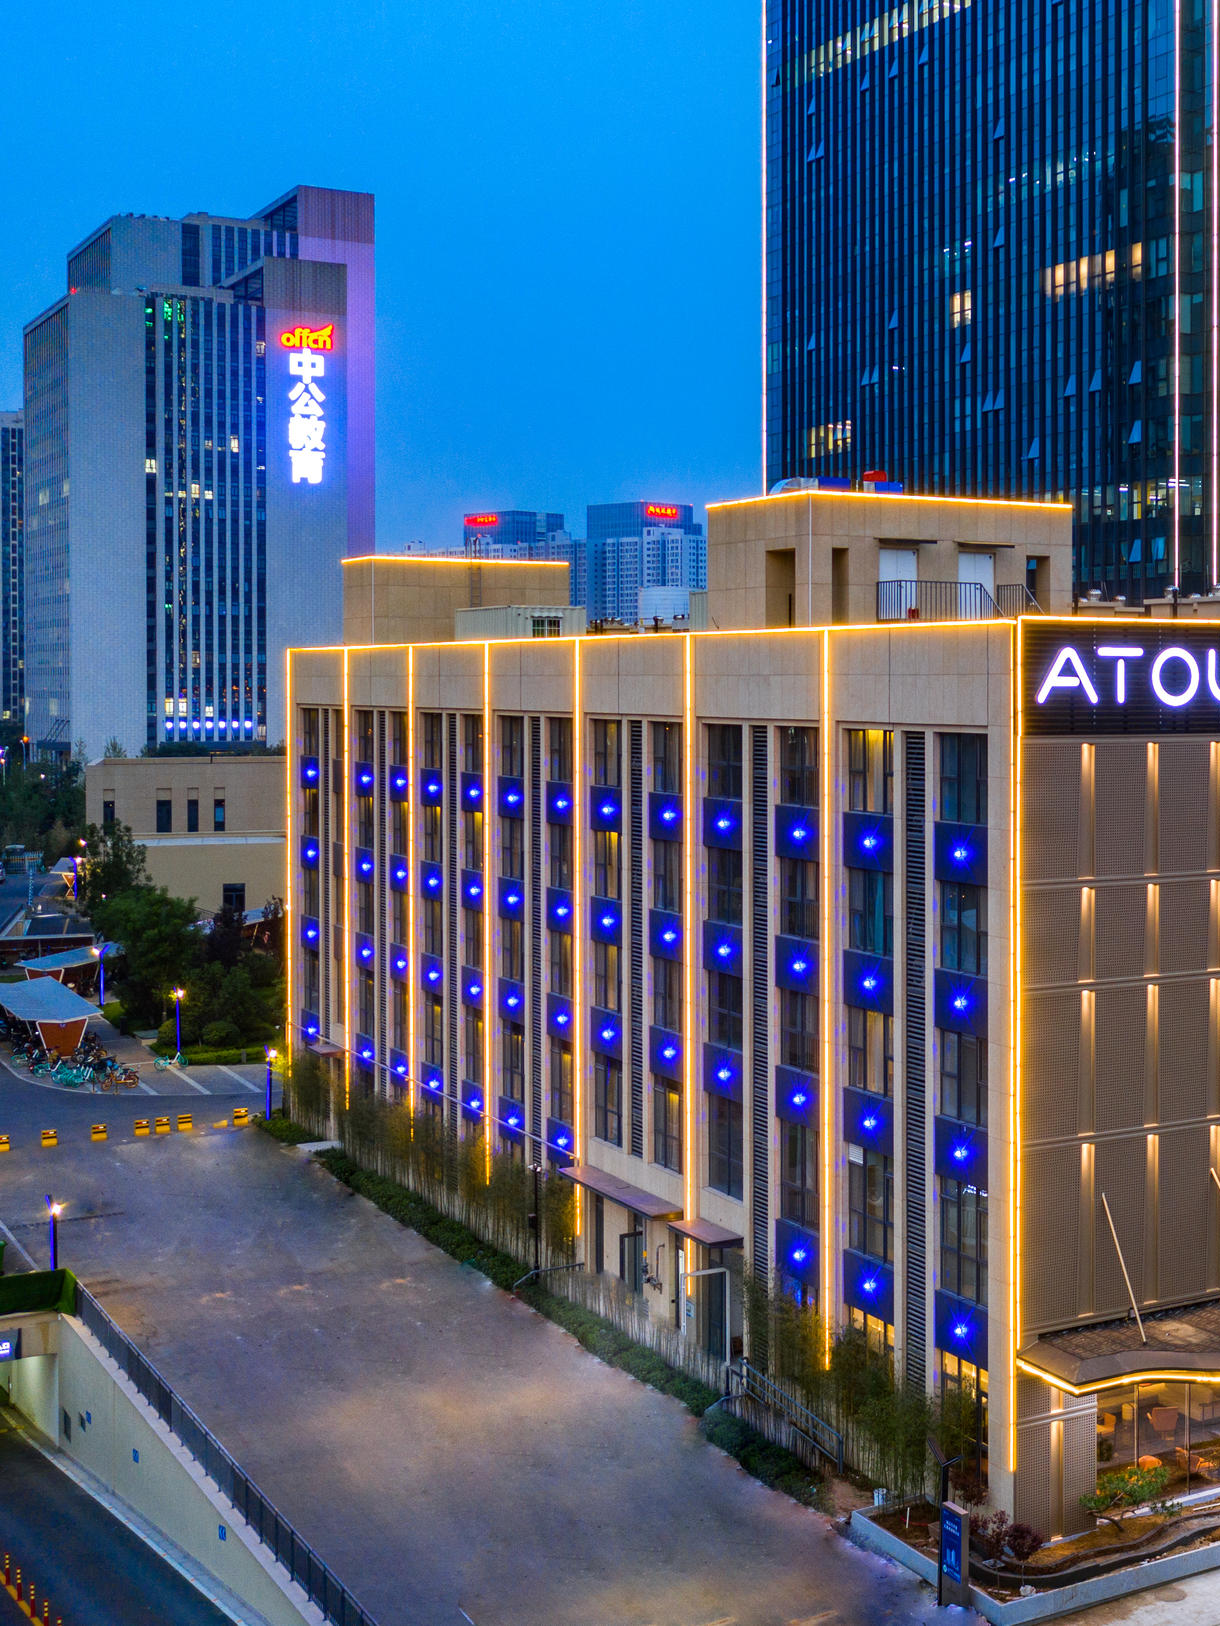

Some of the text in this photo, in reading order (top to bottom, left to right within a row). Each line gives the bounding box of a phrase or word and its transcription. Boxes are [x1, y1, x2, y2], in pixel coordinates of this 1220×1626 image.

[280, 326, 333, 350] offcn
[288, 347, 327, 484] 中公教育
